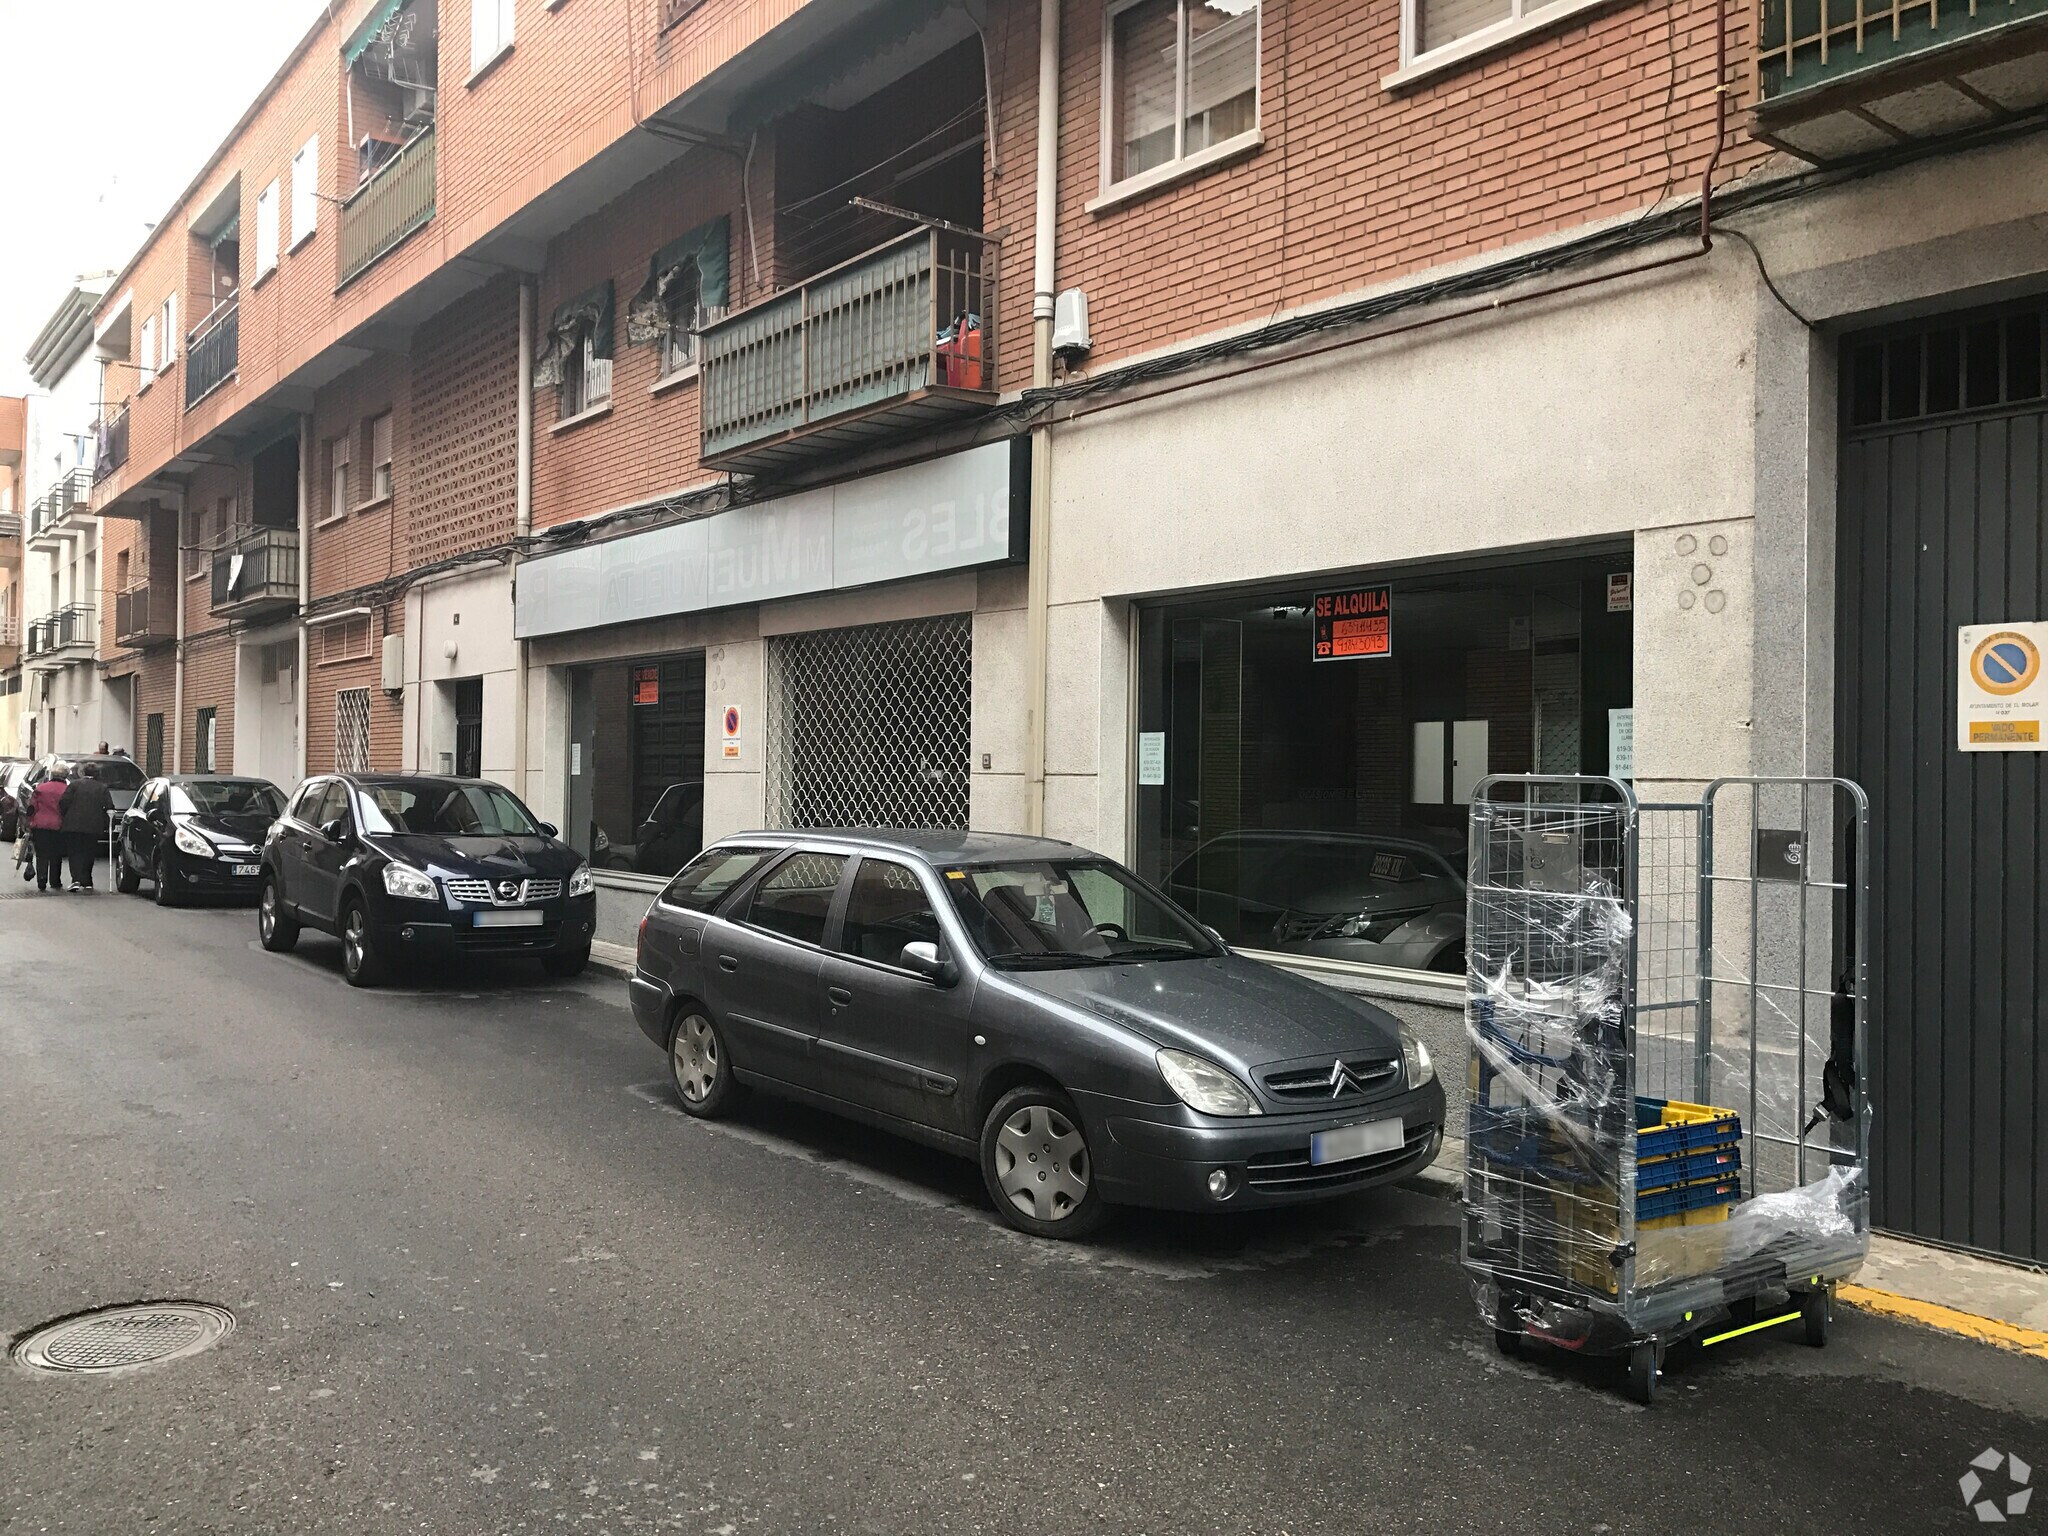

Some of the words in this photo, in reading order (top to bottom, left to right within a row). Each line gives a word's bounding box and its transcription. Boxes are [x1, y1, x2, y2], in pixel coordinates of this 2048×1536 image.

[1316, 596, 1332, 618] SE
[1334, 591, 1388, 615] ALQUILA
[1992, 723, 2015, 732] VADO
[1973, 732, 2034, 742] PERMANENTE
